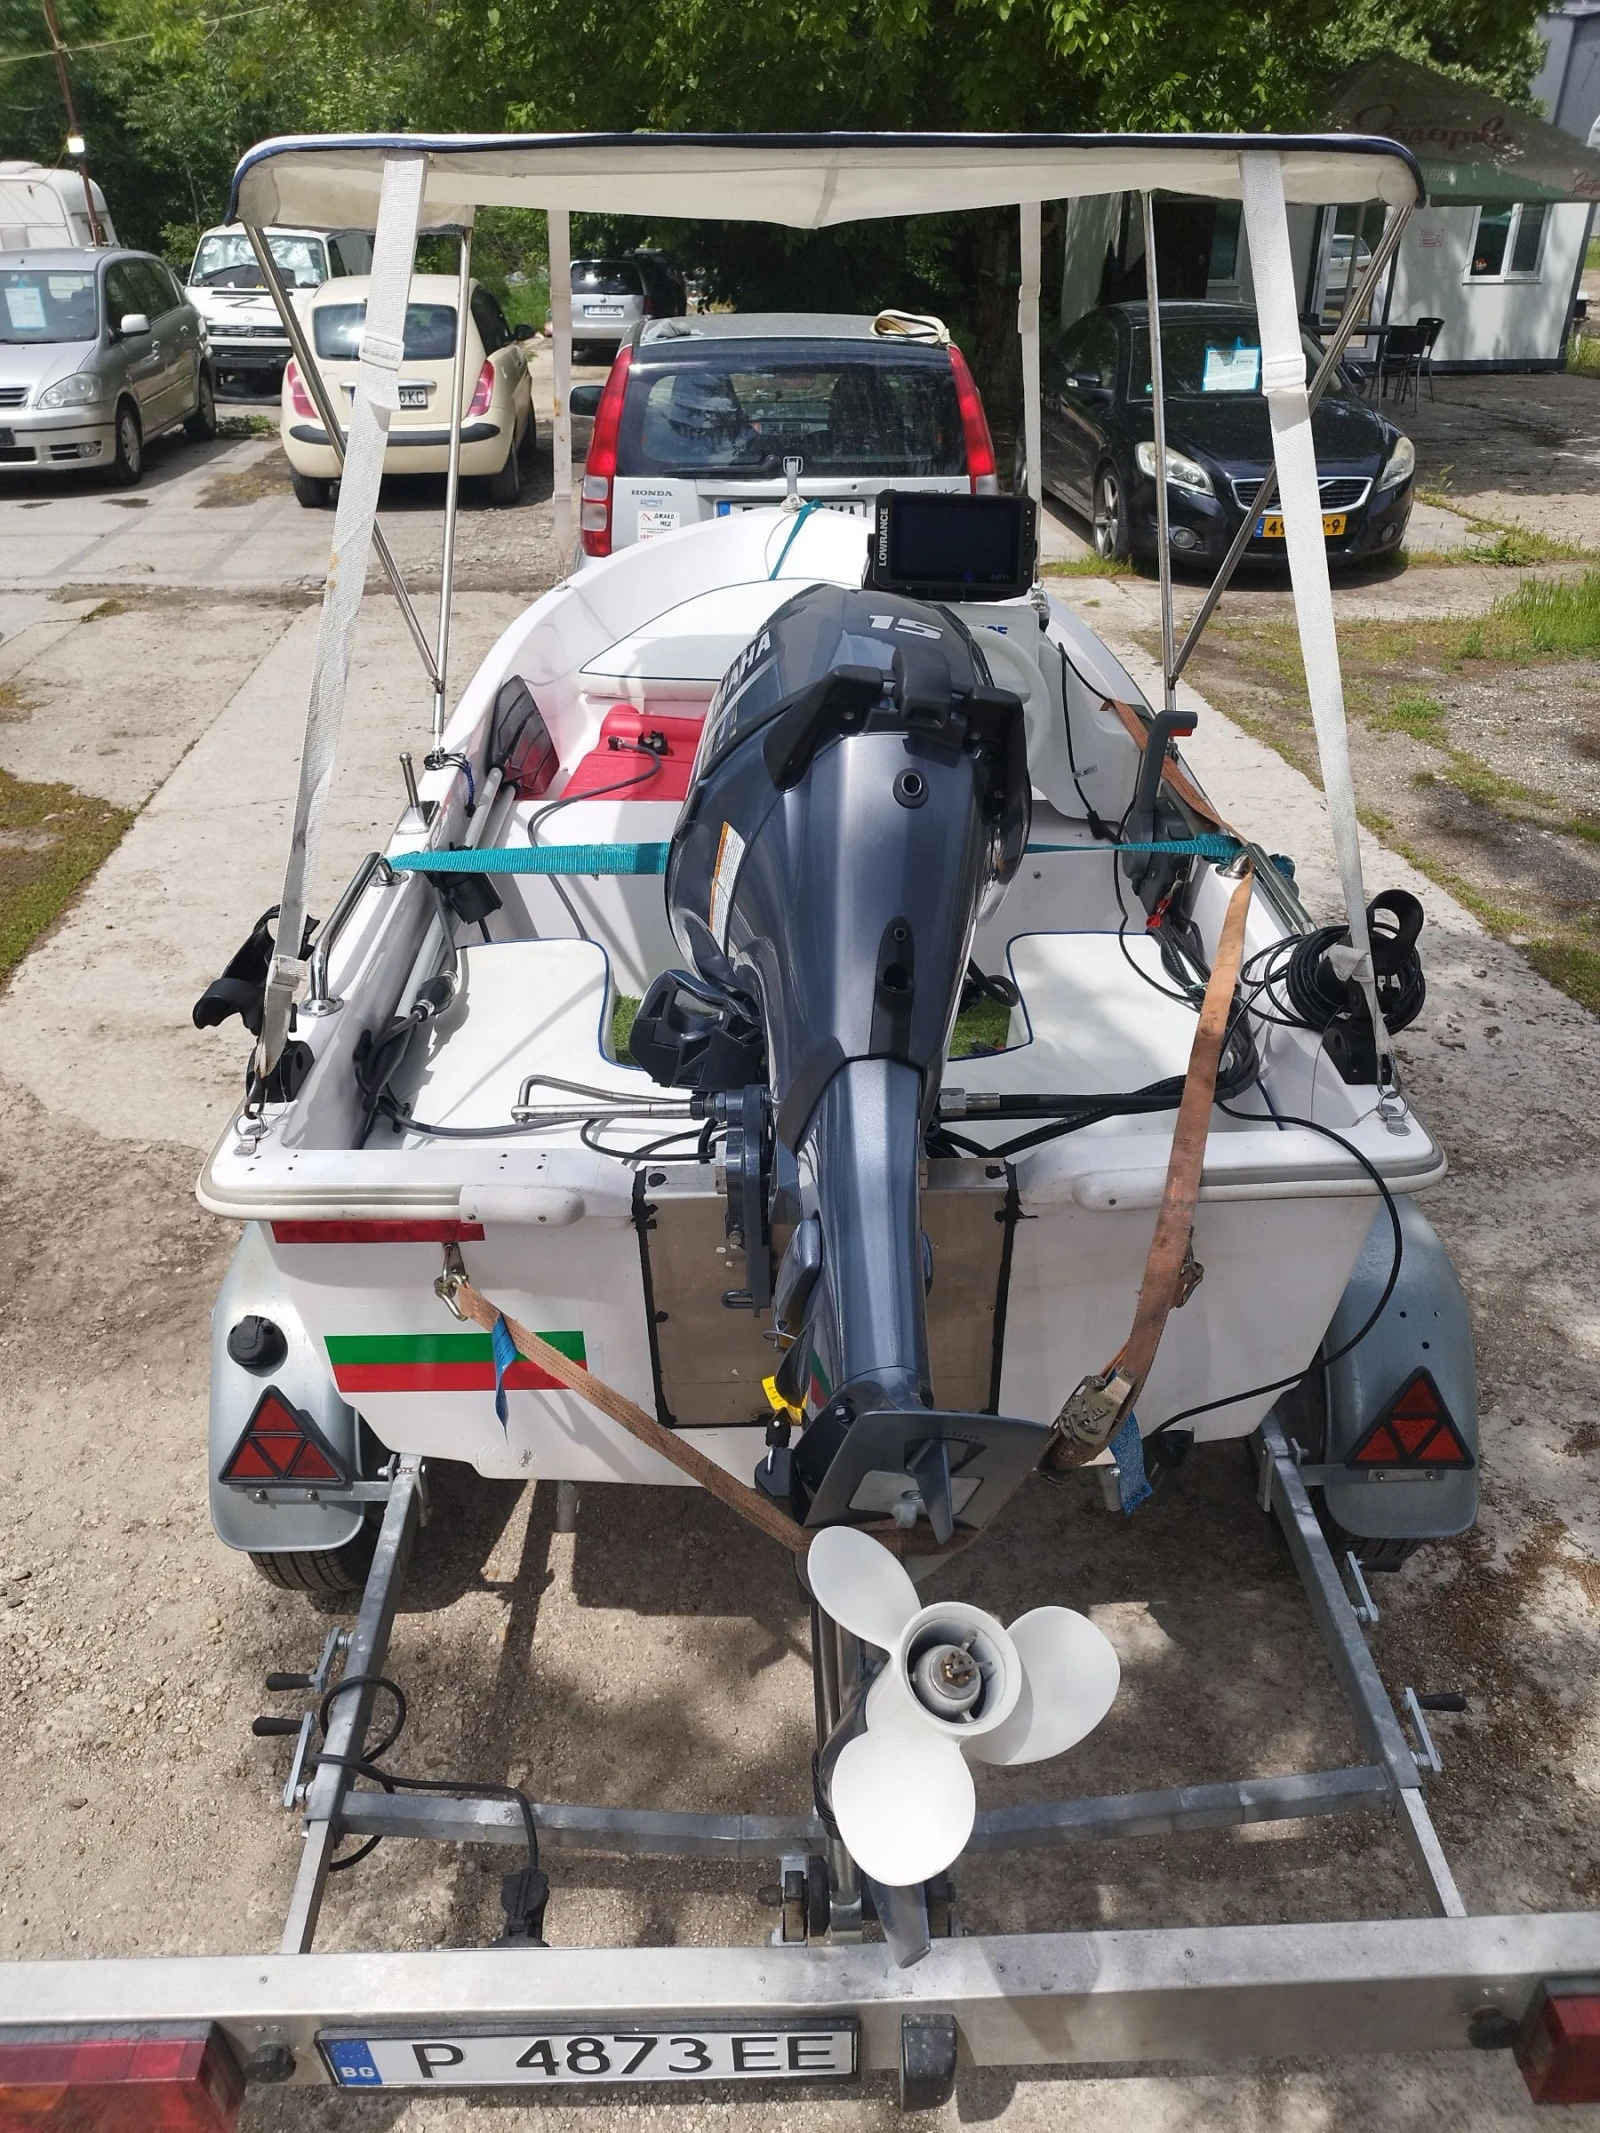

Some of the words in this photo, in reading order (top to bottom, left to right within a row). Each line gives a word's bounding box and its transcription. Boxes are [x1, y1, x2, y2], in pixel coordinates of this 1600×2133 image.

[879, 507, 889, 567] LOWRANCE
[869, 614, 943, 640] 15
[341, 2066, 376, 2079] BG
[412, 2043, 465, 2079] P
